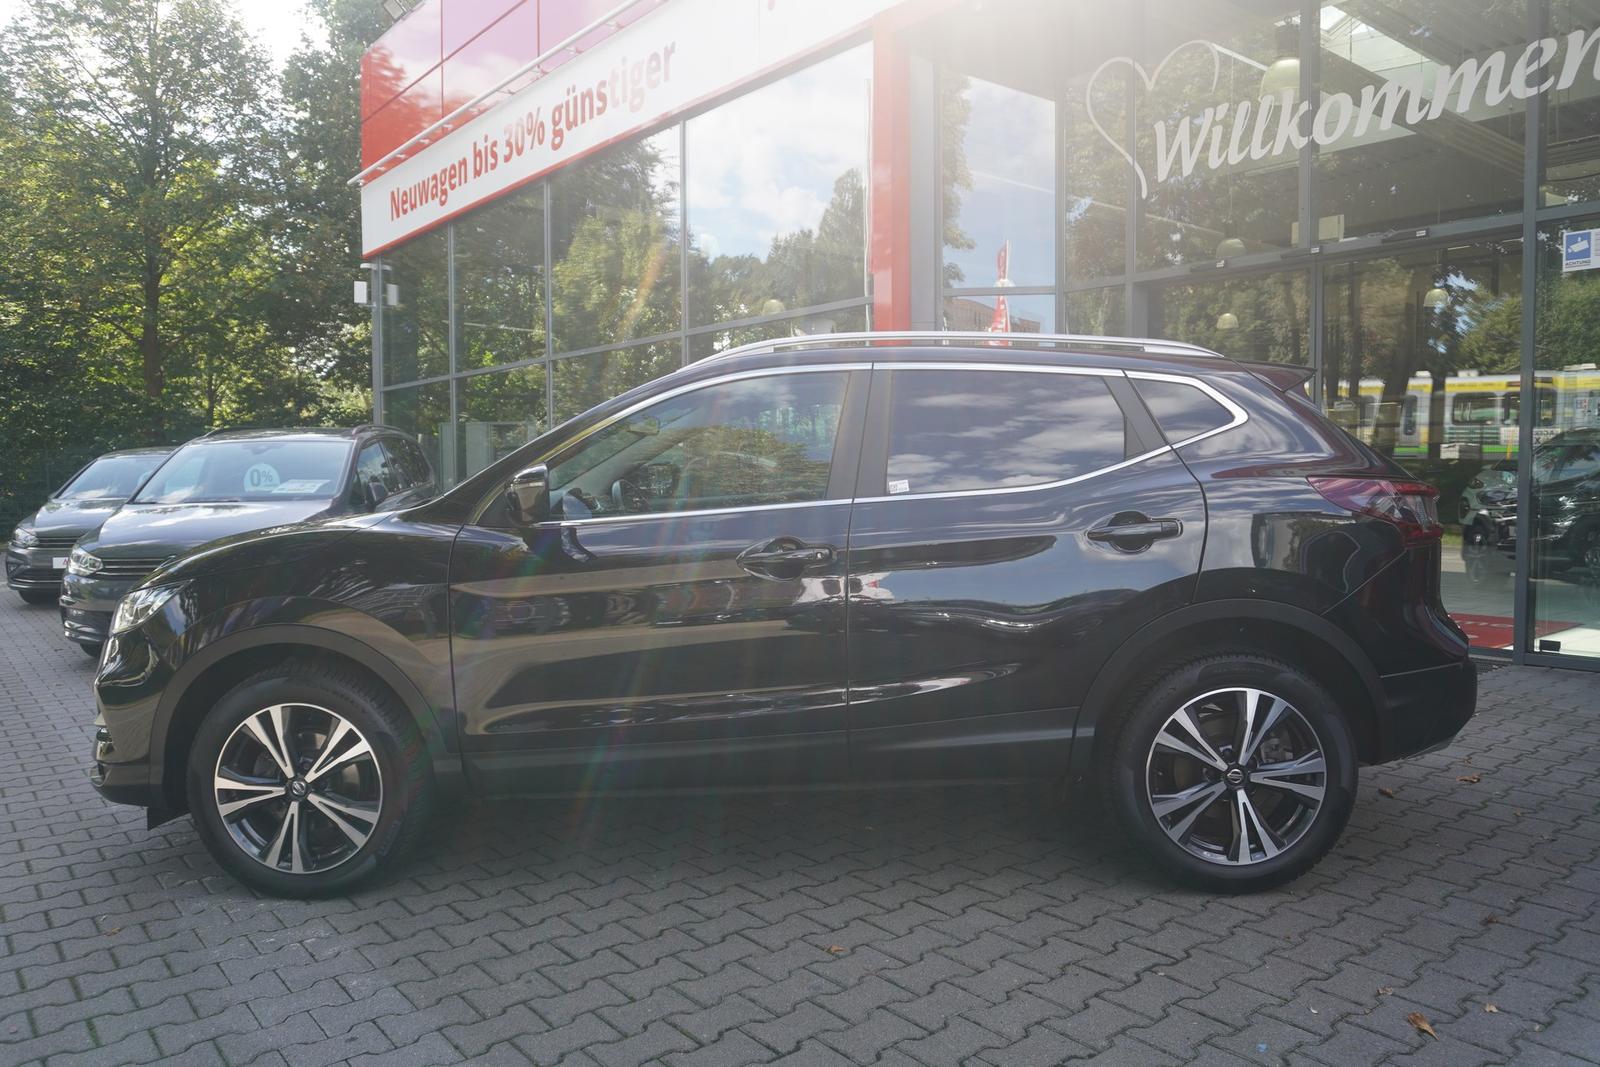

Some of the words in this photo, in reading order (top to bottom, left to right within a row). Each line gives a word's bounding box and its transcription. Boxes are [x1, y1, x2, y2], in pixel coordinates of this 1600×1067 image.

[390, 155, 469, 222] Neuwagen
[472, 134, 498, 178] bis
[503, 107, 546, 164] 30%
[550, 40, 677, 152] günstiger
[1153, 29, 1600, 184] Willkommen
[250, 468, 273, 487] 0%
